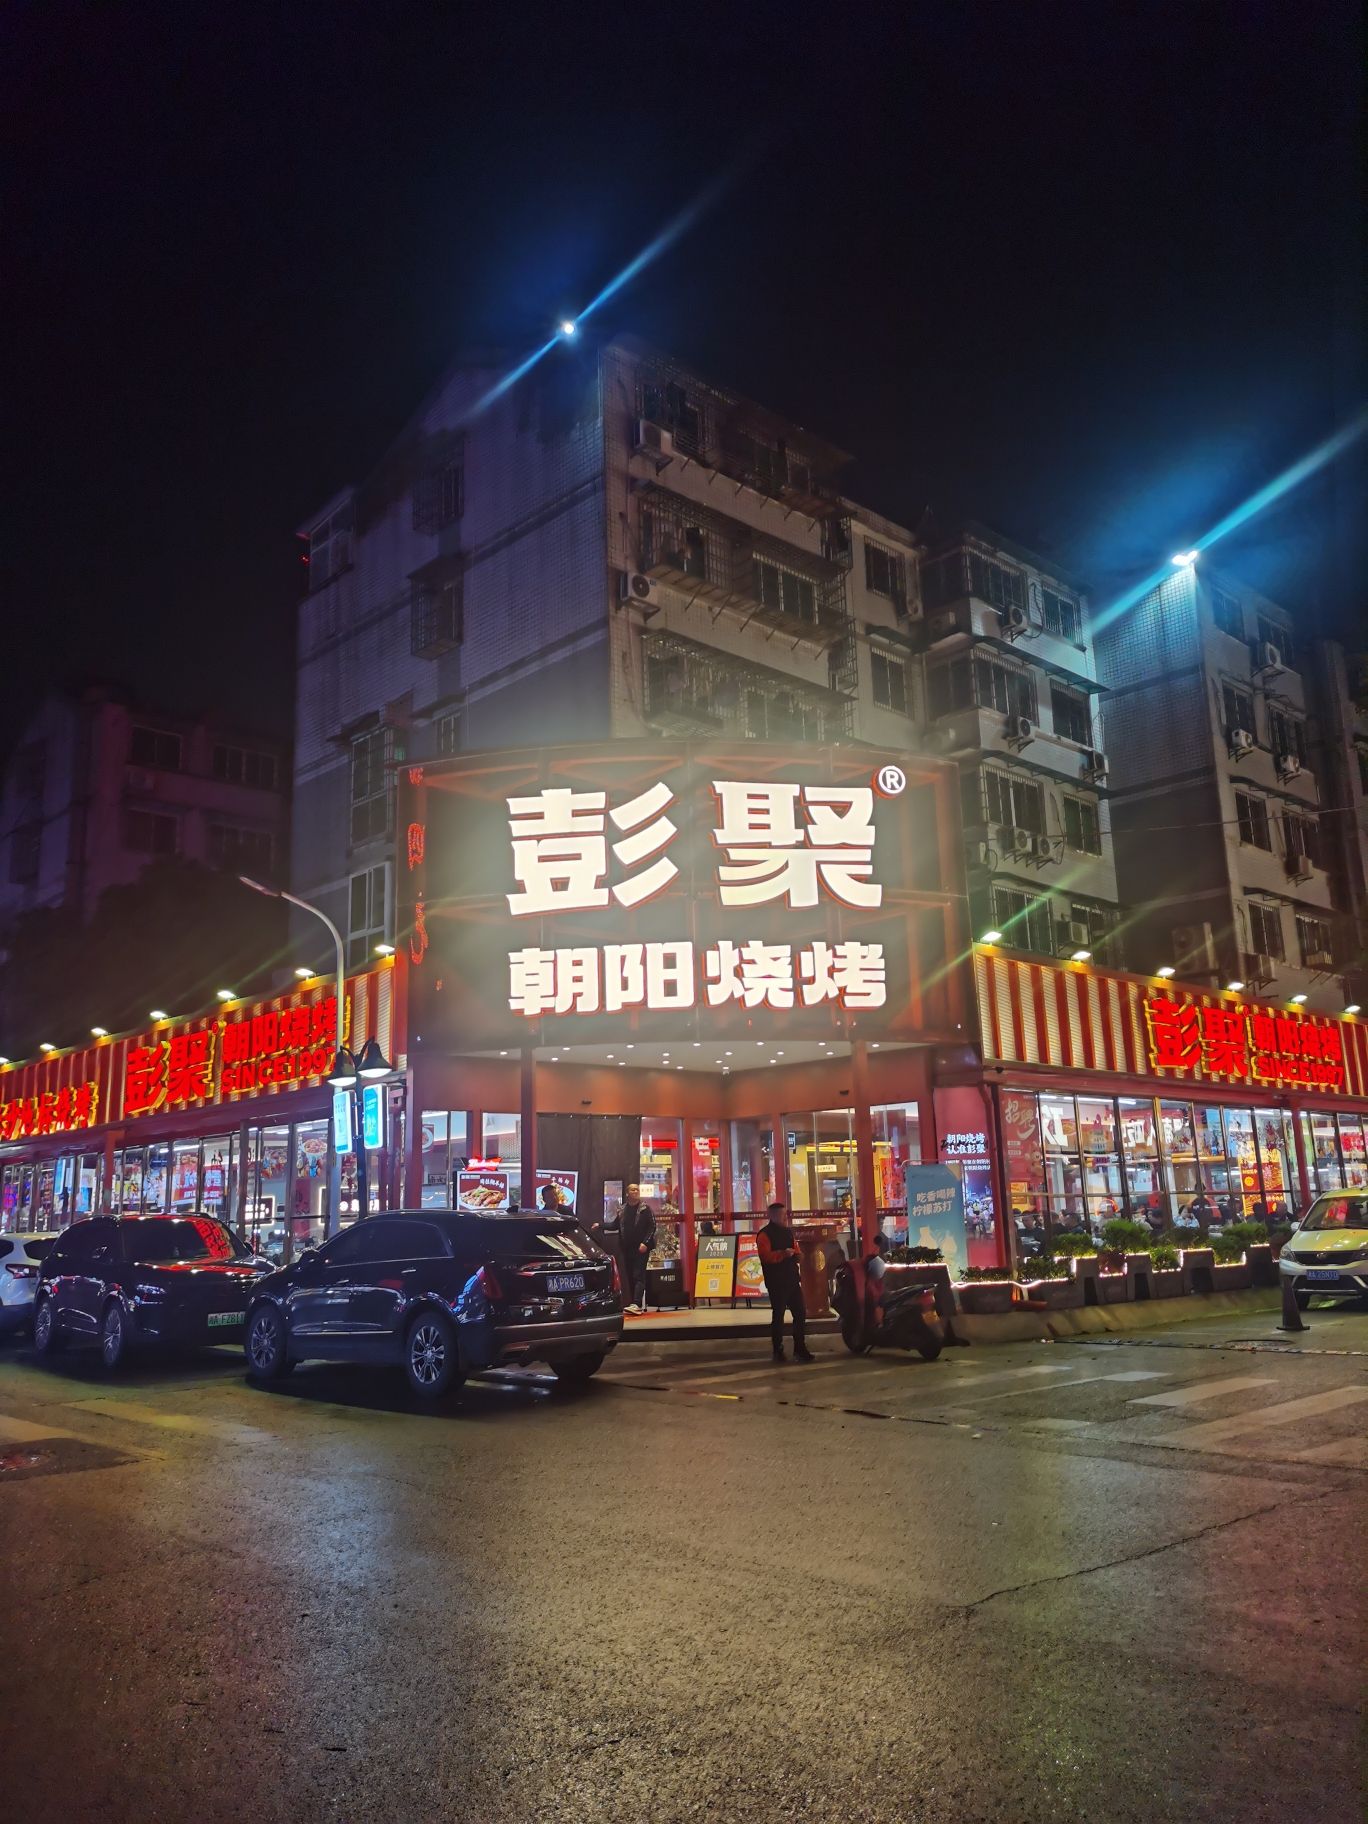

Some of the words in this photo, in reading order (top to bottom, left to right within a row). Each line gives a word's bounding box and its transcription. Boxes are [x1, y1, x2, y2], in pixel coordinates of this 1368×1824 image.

[506, 780, 883, 916] 彭聚
[509, 939, 887, 1016] 朝阳烧烤
[124, 1029, 214, 1114] 彭聚
[1150, 998, 1249, 1078] 彭聚
[1253, 1014, 1342, 1062] 朝阳烧烤
[946, 1133, 986, 1144] 朝阳烧烤
[946, 1144, 987, 1155] 认准彭聚
